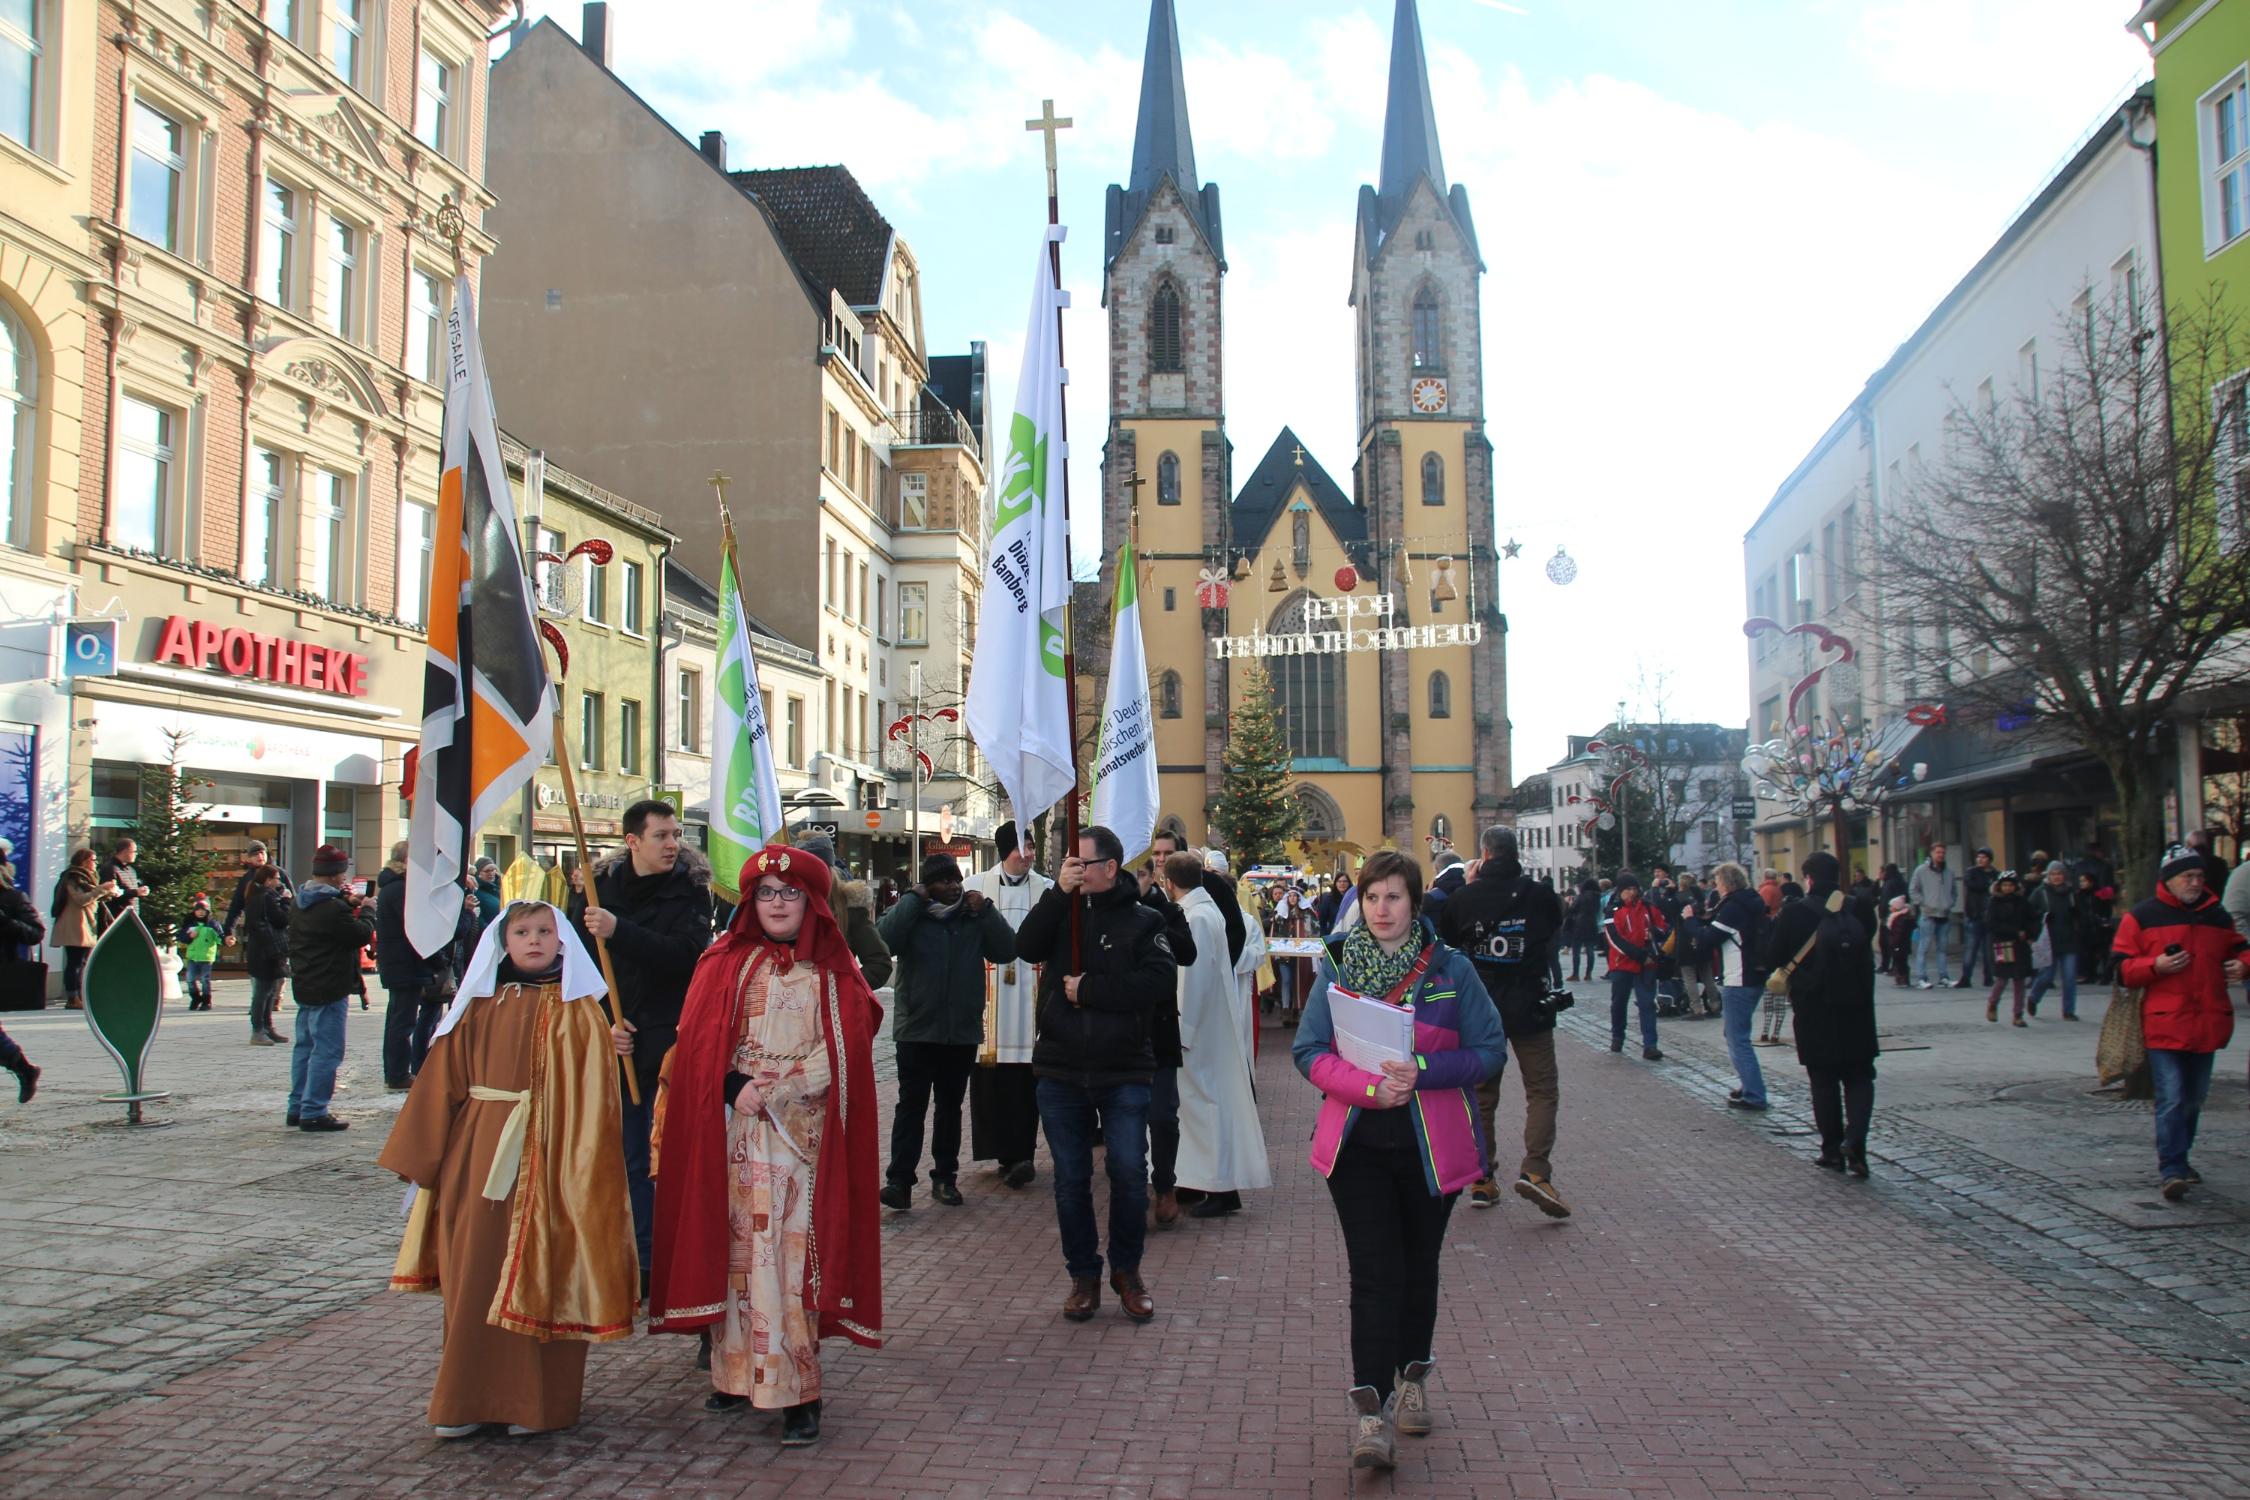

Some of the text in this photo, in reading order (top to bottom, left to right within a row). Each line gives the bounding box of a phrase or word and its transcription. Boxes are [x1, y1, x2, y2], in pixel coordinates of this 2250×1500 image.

[992, 554, 1028, 613] Bamberg
[1008, 539, 1030, 584] Diöze
[155, 615, 368, 697] APOTHEKE
